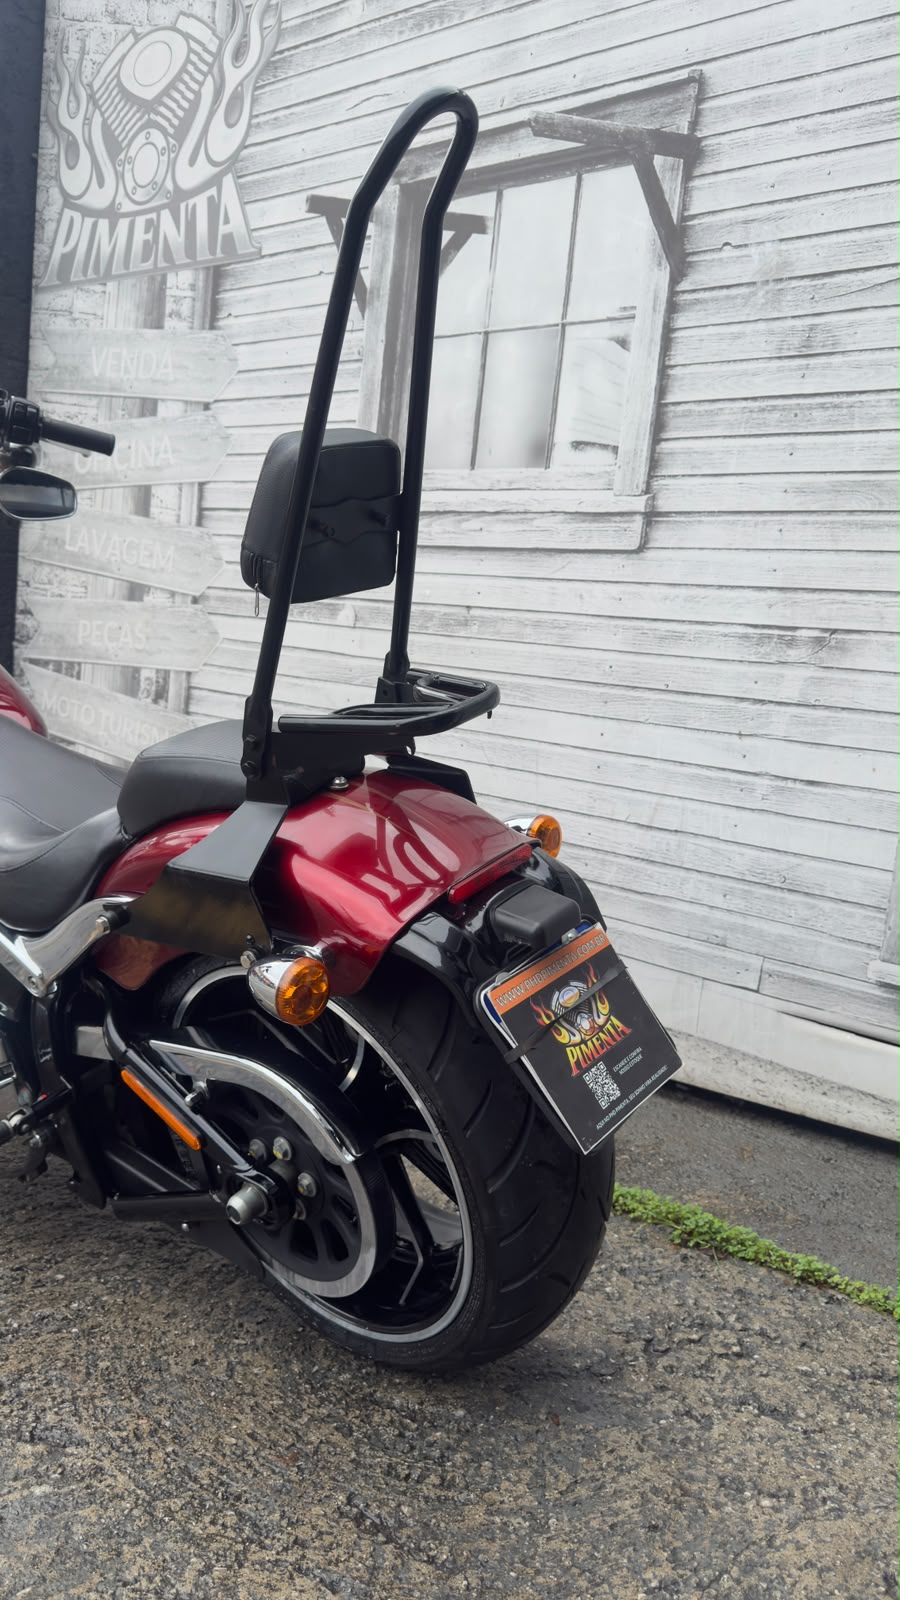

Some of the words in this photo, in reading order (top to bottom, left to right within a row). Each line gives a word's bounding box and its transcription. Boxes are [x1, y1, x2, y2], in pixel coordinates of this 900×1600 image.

[43, 170, 250, 287] PIMENTA
[91, 346, 174, 380] VENDA
[65, 524, 175, 571] LAVAGEM
[77, 619, 147, 651] PEÇAS
[41, 689, 95, 725] MOTO
[495, 933, 606, 1007] WWW.PHDPIMENTA.COM.BR
[565, 1015, 632, 1077] PIMENTA
